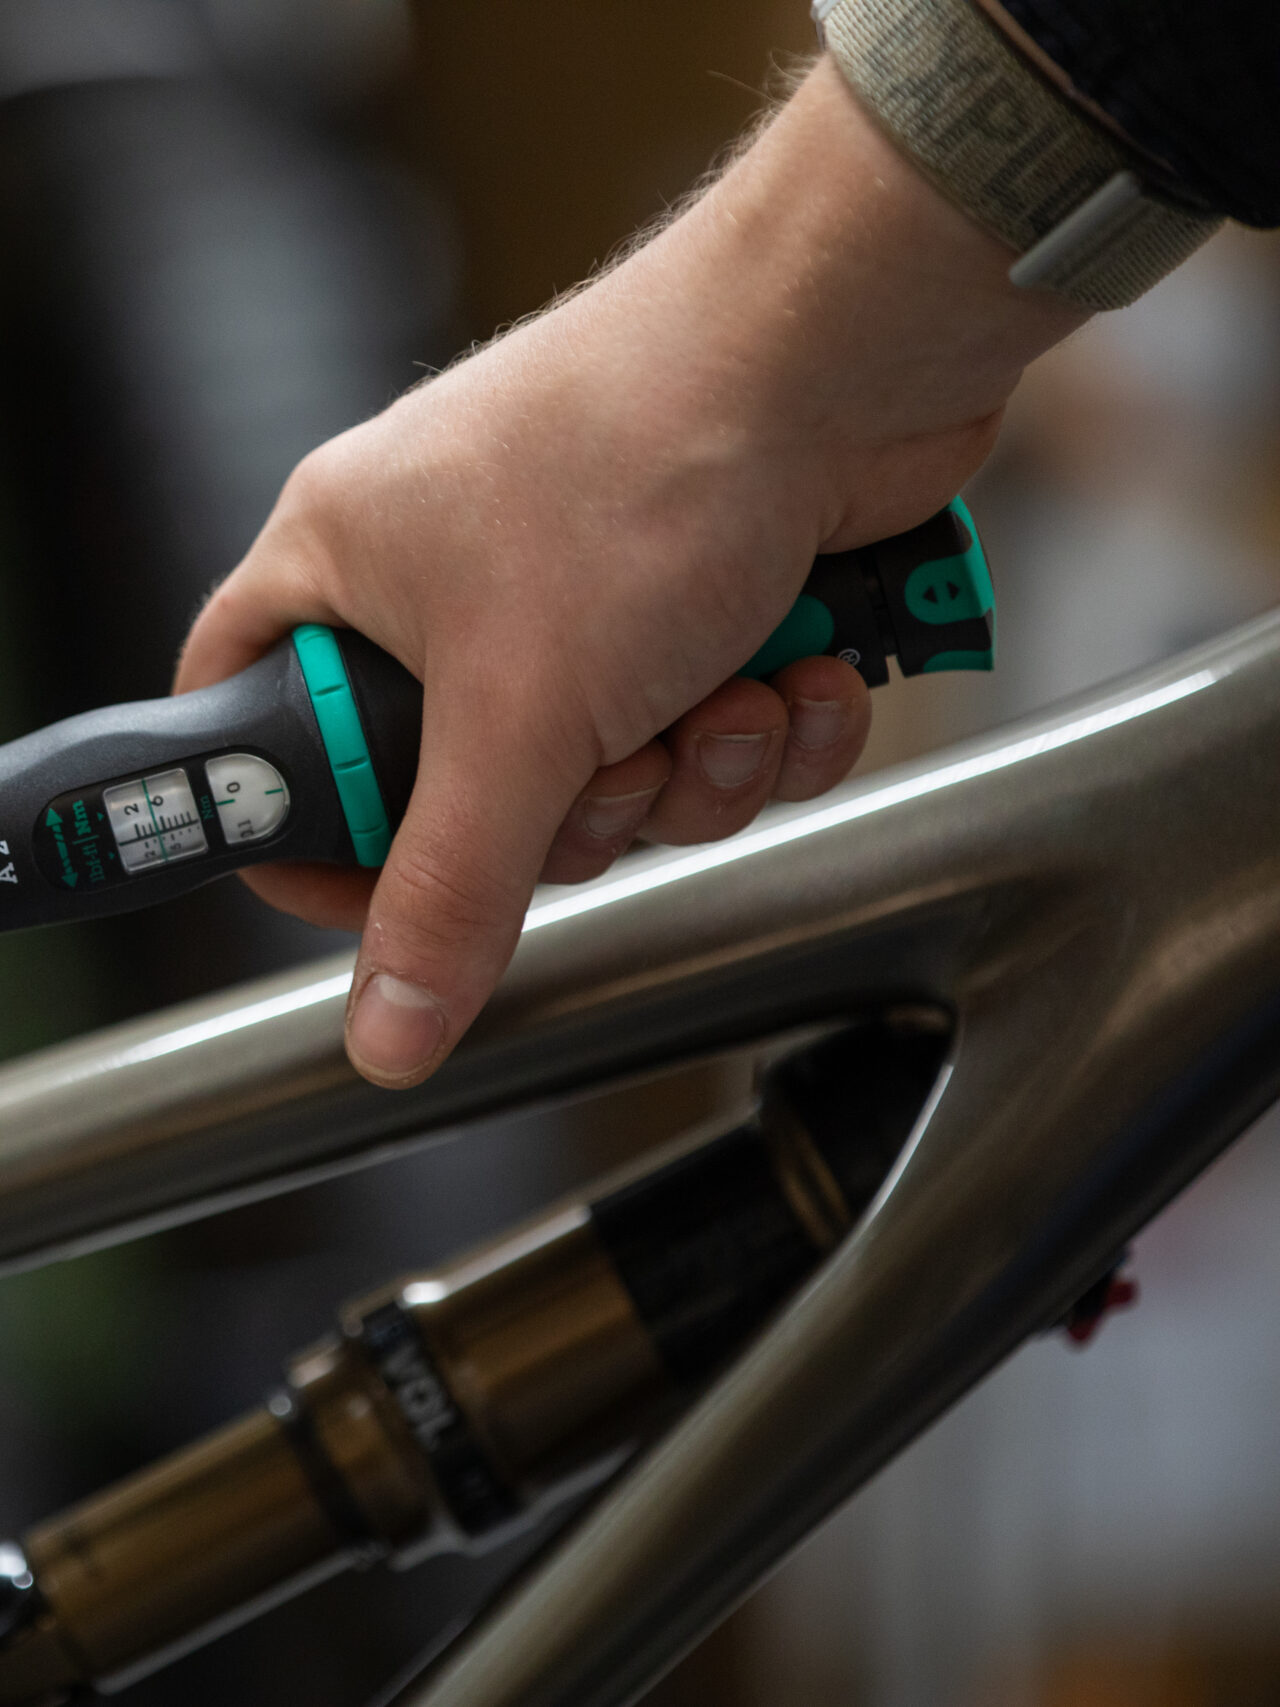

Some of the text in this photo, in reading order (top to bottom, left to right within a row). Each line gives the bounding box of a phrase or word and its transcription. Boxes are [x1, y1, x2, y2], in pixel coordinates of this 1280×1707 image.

[226, 781, 241, 793] 0
[151, 795, 164, 807] 6
[124, 803, 139, 815] 2
[73, 800, 91, 836] Nm
